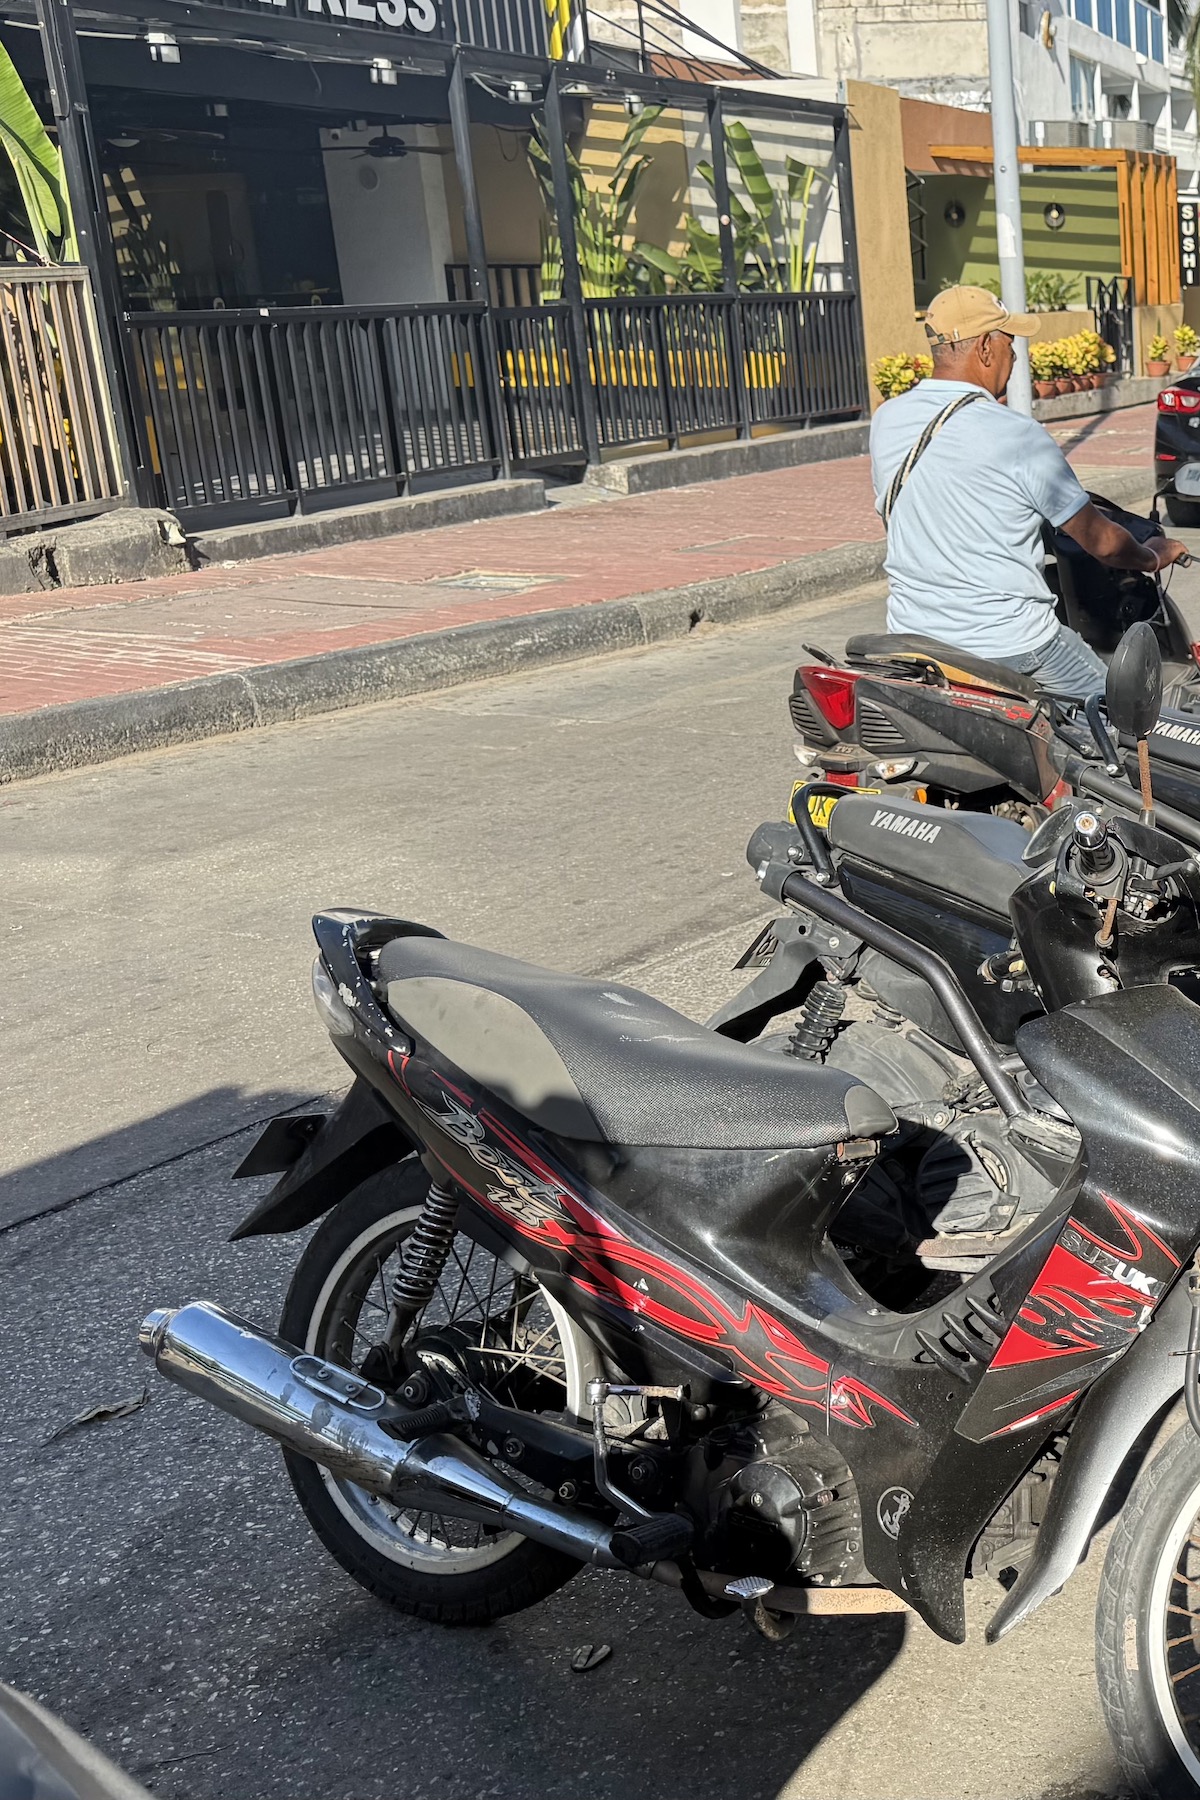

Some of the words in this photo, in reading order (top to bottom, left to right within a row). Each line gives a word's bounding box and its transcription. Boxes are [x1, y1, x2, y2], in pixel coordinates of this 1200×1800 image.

[1181, 204, 1197, 285] SUSHI
[869, 809, 942, 844] YAMAHA
[1061, 1229, 1167, 1299] SUZUKI
